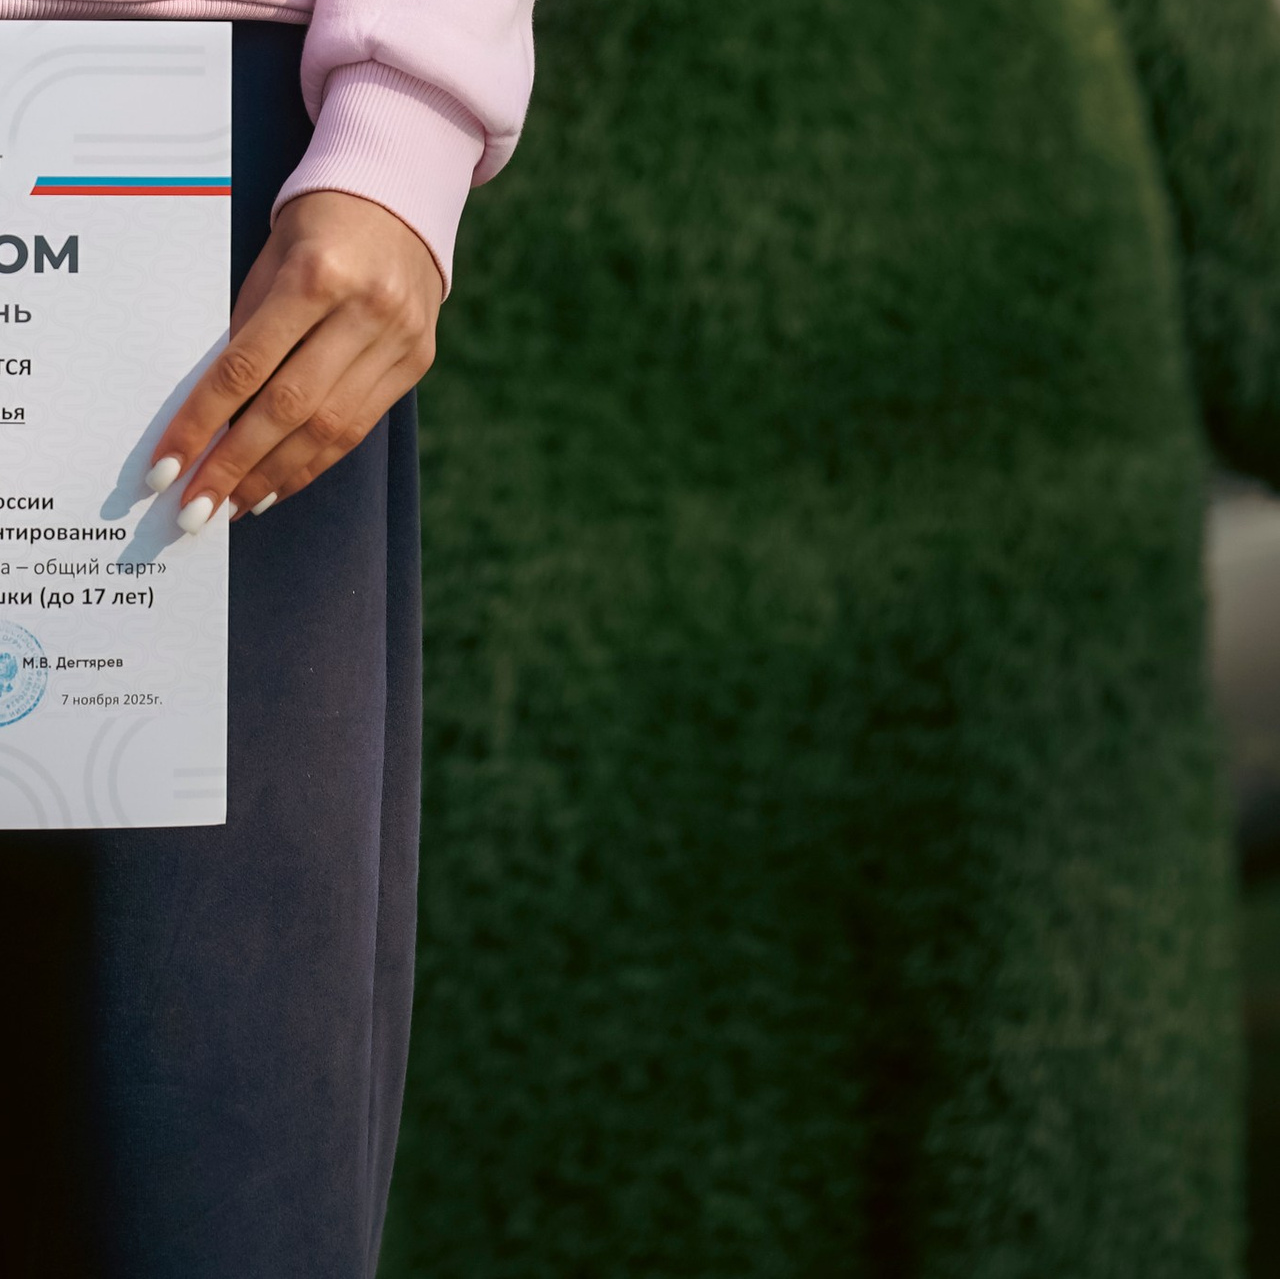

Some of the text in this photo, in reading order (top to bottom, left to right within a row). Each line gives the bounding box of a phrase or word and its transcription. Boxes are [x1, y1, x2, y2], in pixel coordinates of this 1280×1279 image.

[33, 557, 98, 578] общий
[105, 562, 166, 578] старт»
[40, 586, 74, 608] (до
[82, 588, 105, 604] 17
[111, 586, 153, 608] лет)
[22, 656, 123, 670] М.В. Дегтярев
[61, 693, 162, 707] 7 ноября 2025г.
